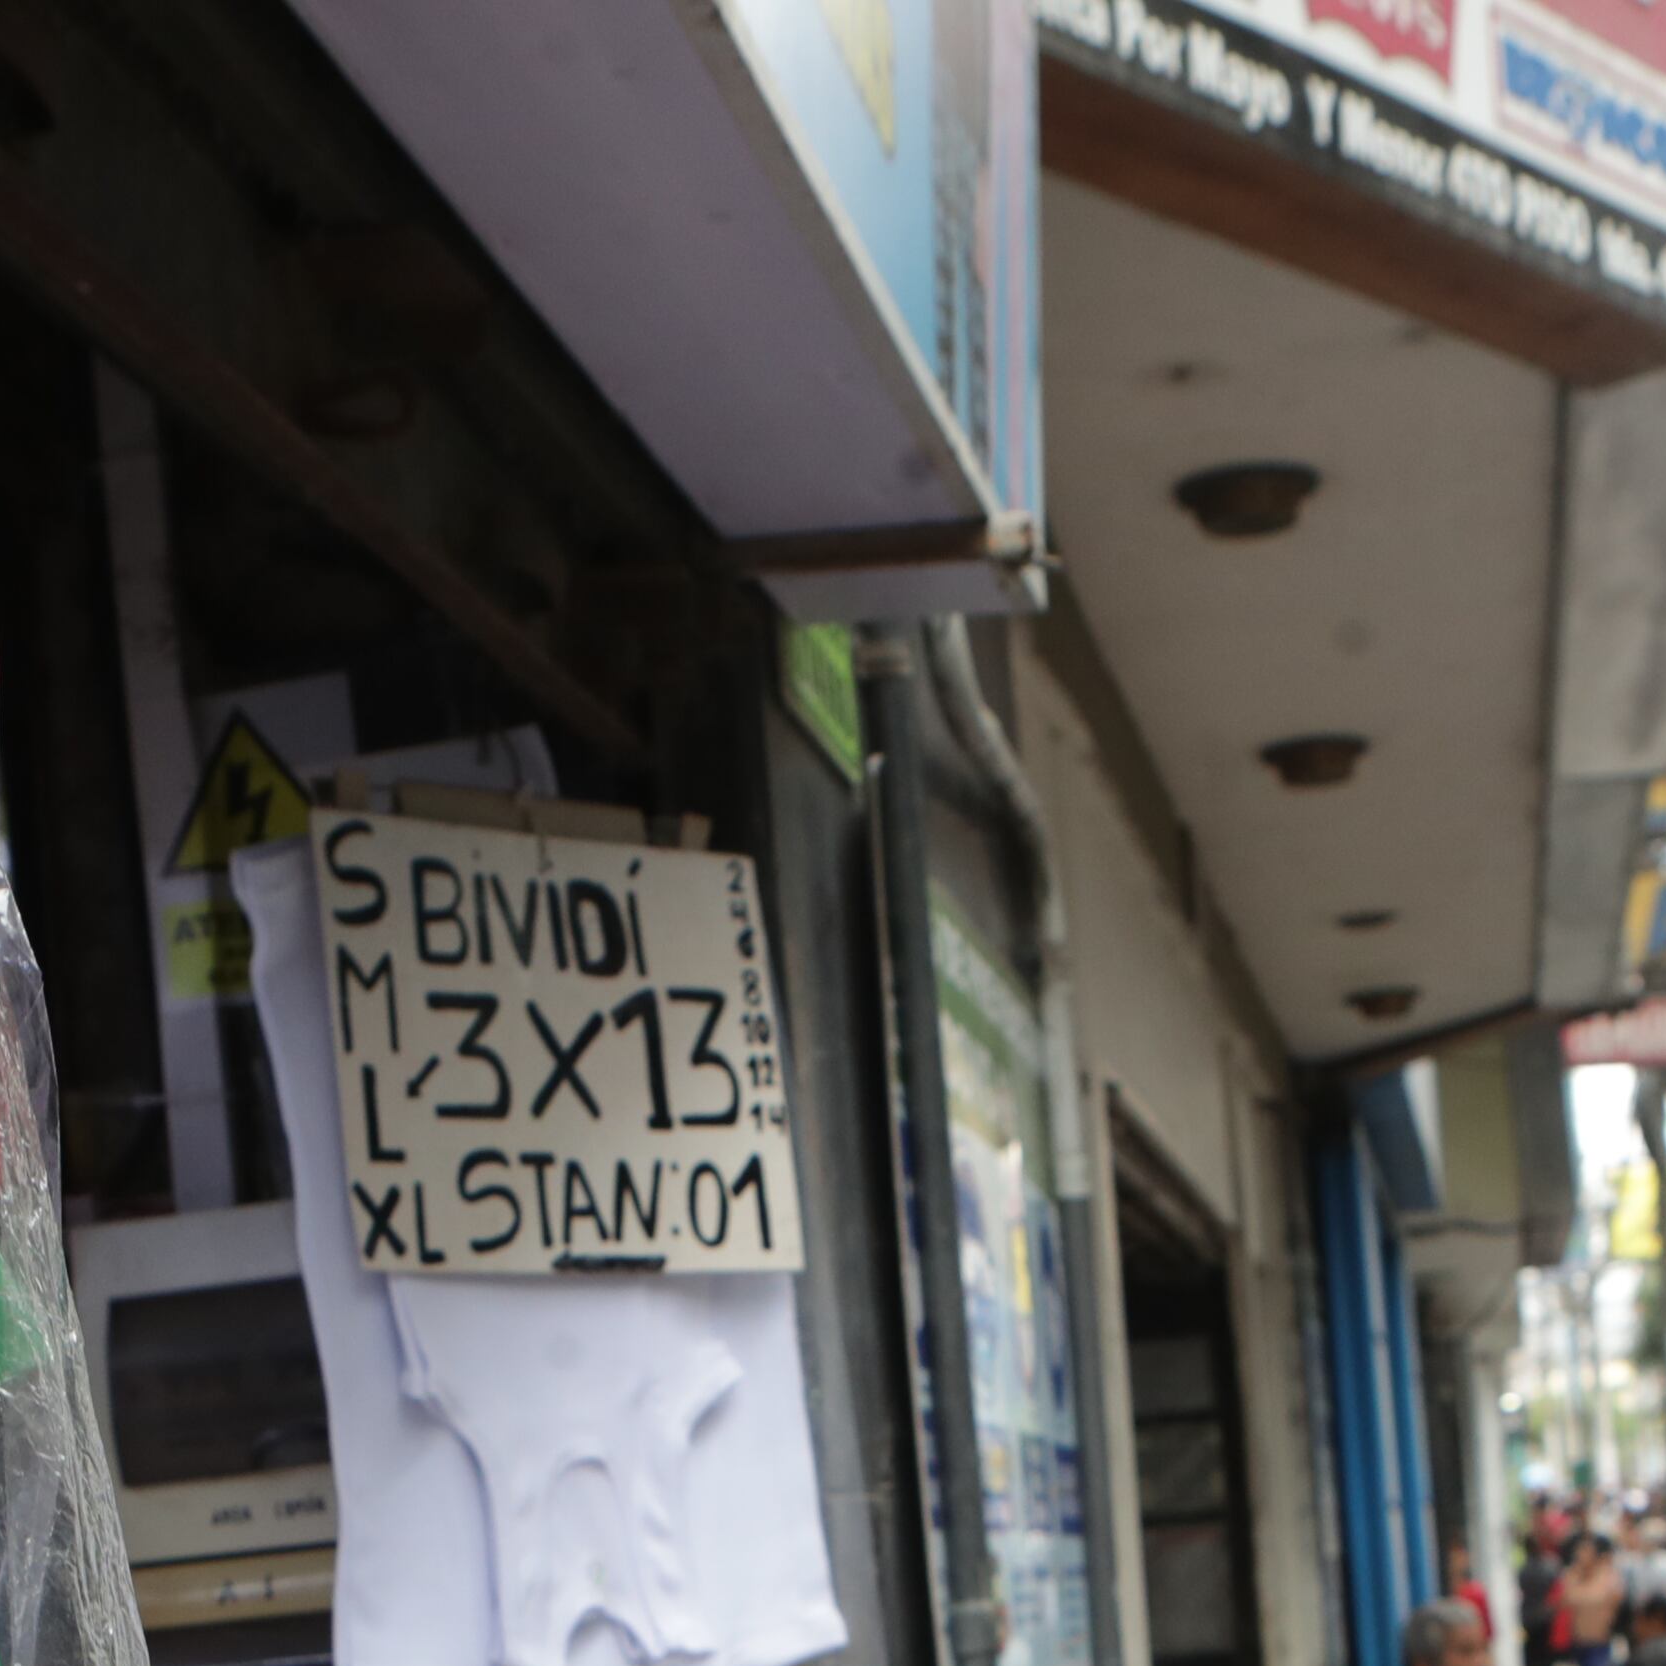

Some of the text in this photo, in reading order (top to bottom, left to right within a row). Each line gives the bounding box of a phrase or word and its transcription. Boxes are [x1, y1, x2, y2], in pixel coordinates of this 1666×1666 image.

[323, 821, 387, 924] S
[726, 861, 743, 893] 2
[337, 946, 399, 1053] M
[742, 968, 761, 1008] 8
[742, 1012, 771, 1045] 10
[425, 988, 739, 1131] 3X13
[748, 1054, 775, 1087] 12
[363, 1065, 405, 1162] L
[750, 1103, 786, 1135] 14
[353, 1184, 445, 1264] XL
